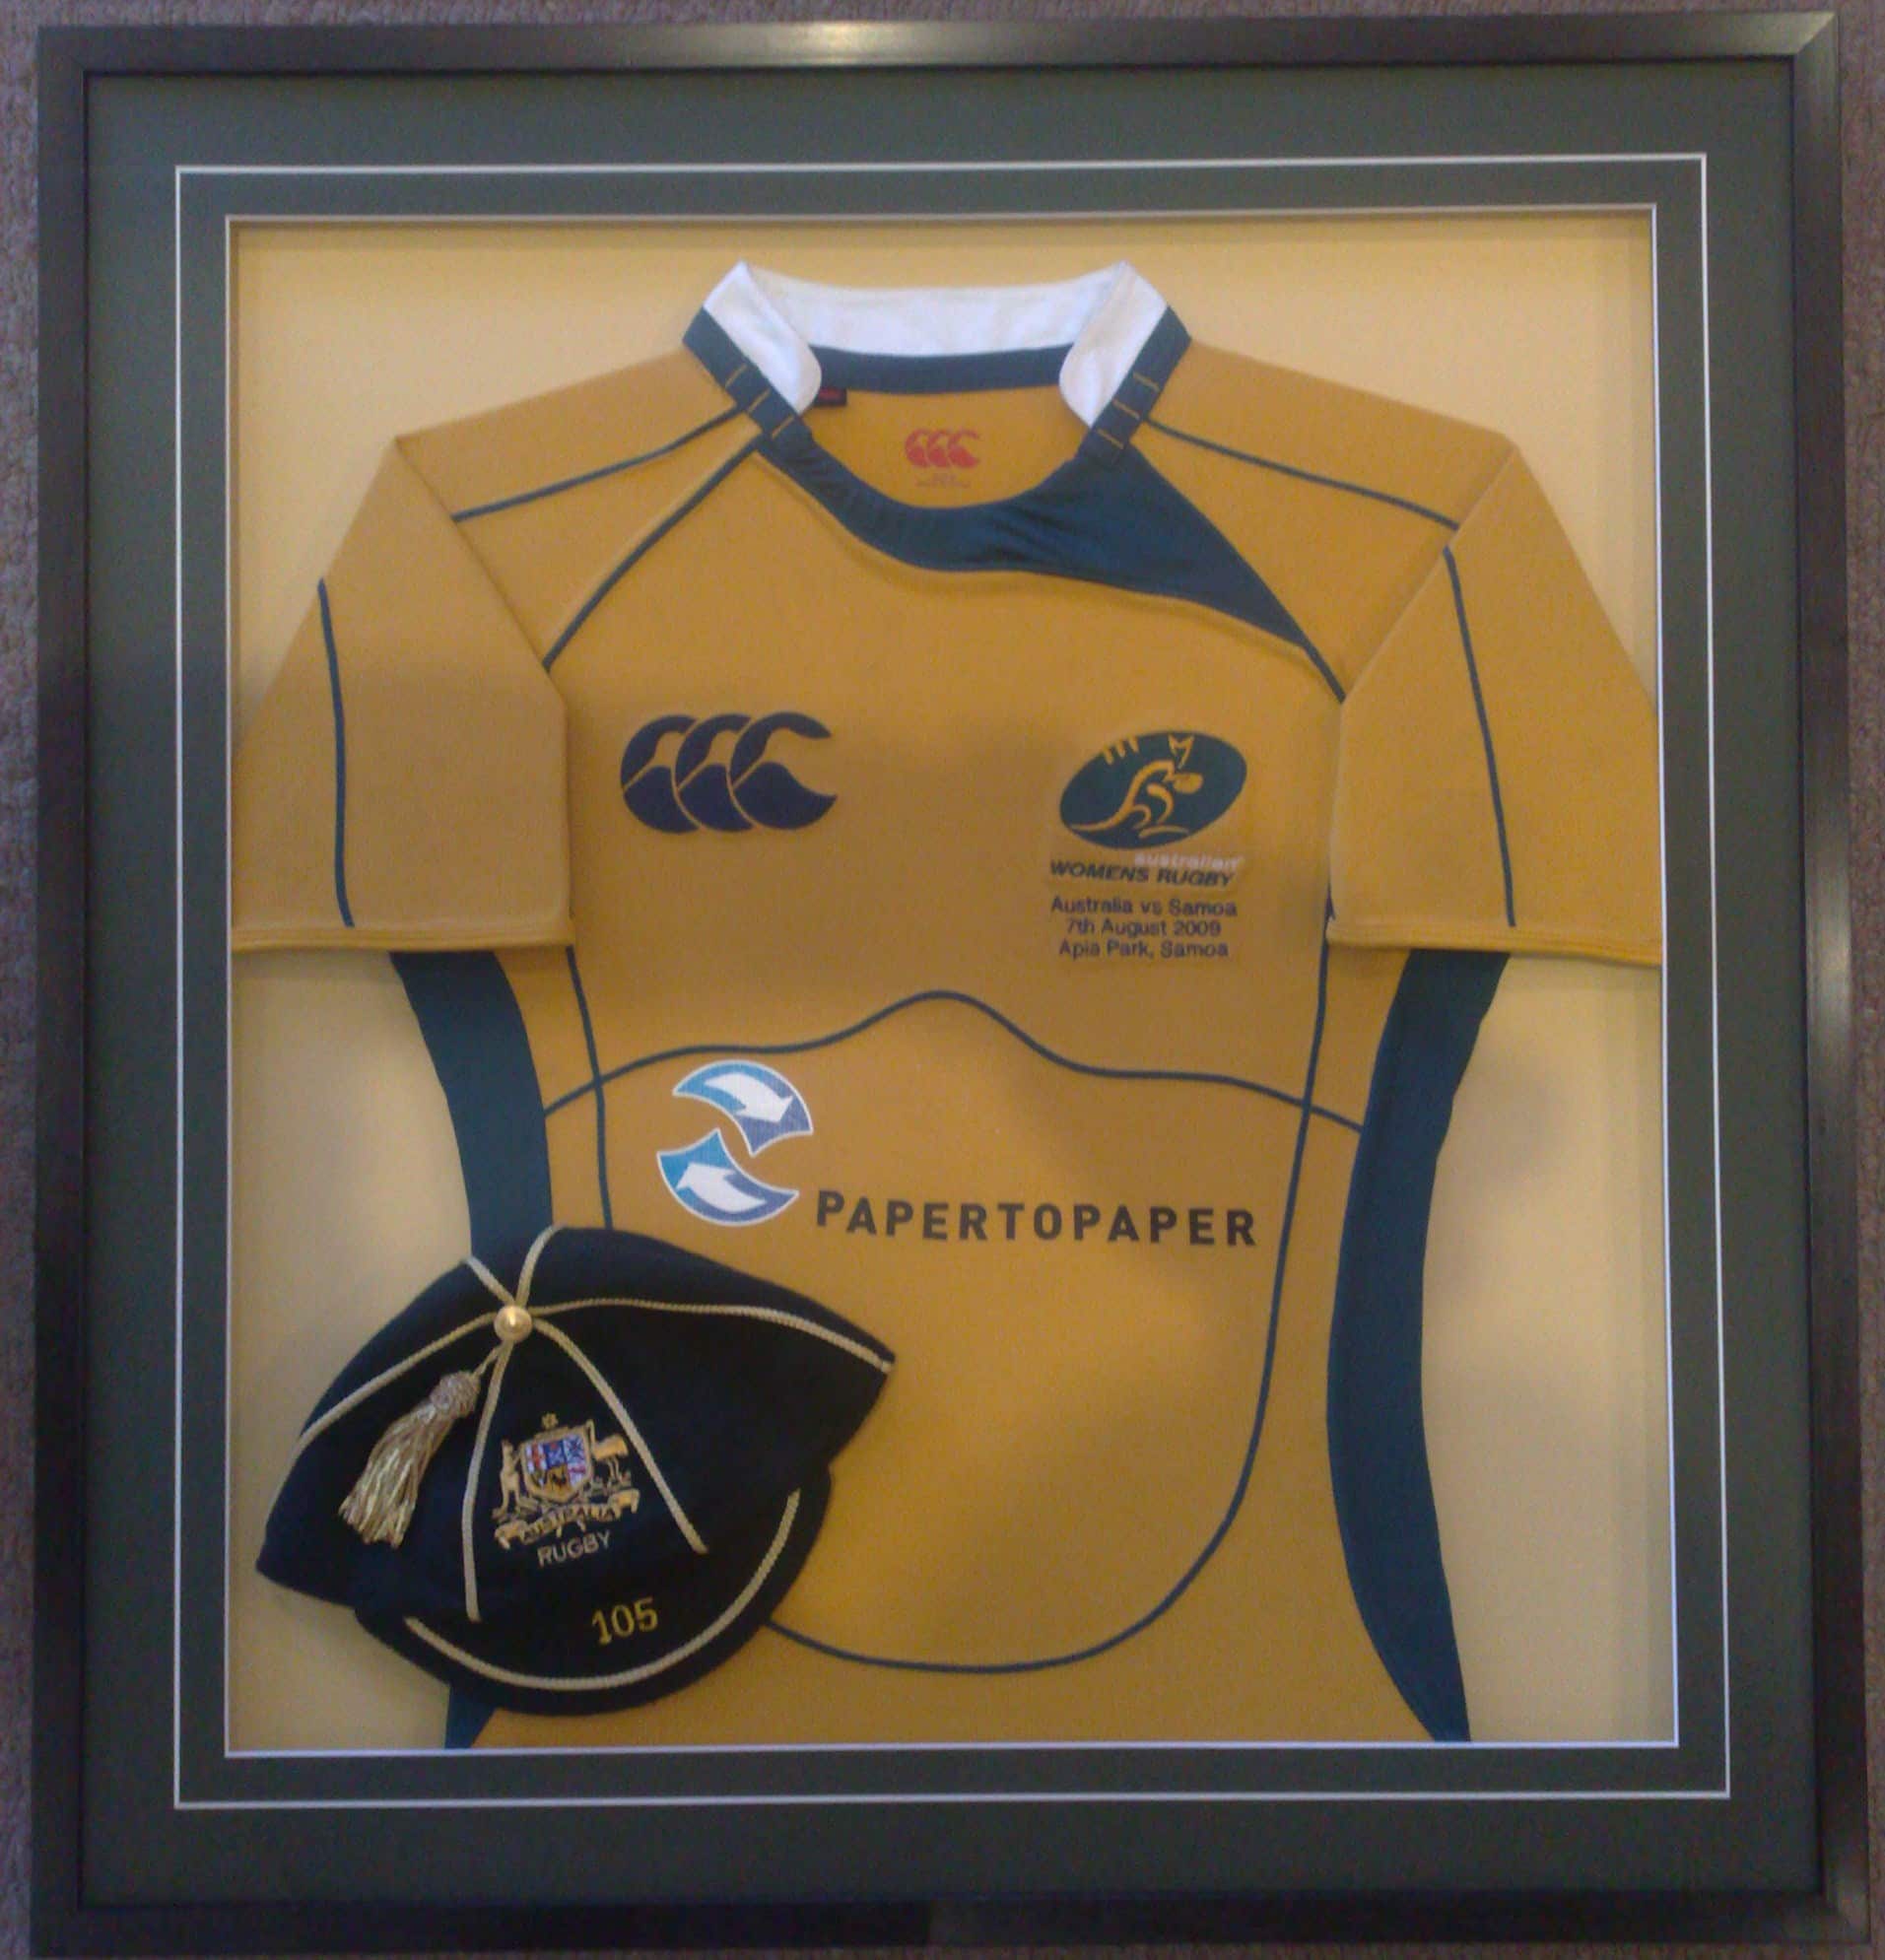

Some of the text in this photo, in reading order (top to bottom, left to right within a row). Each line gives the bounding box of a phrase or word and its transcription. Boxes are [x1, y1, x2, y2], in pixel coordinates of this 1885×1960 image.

[1050, 858, 1236, 887] WOMENS RUGBY
[1051, 895, 1238, 917] Australia vs Samoa
[1067, 917, 1223, 938] 7th August 2009
[1059, 939, 1230, 960] Apia Park, Samoa
[816, 1188, 1257, 1247] PAPERTOPAPER
[537, 1530, 611, 1568] RUGBY
[592, 1596, 658, 1646] 105
